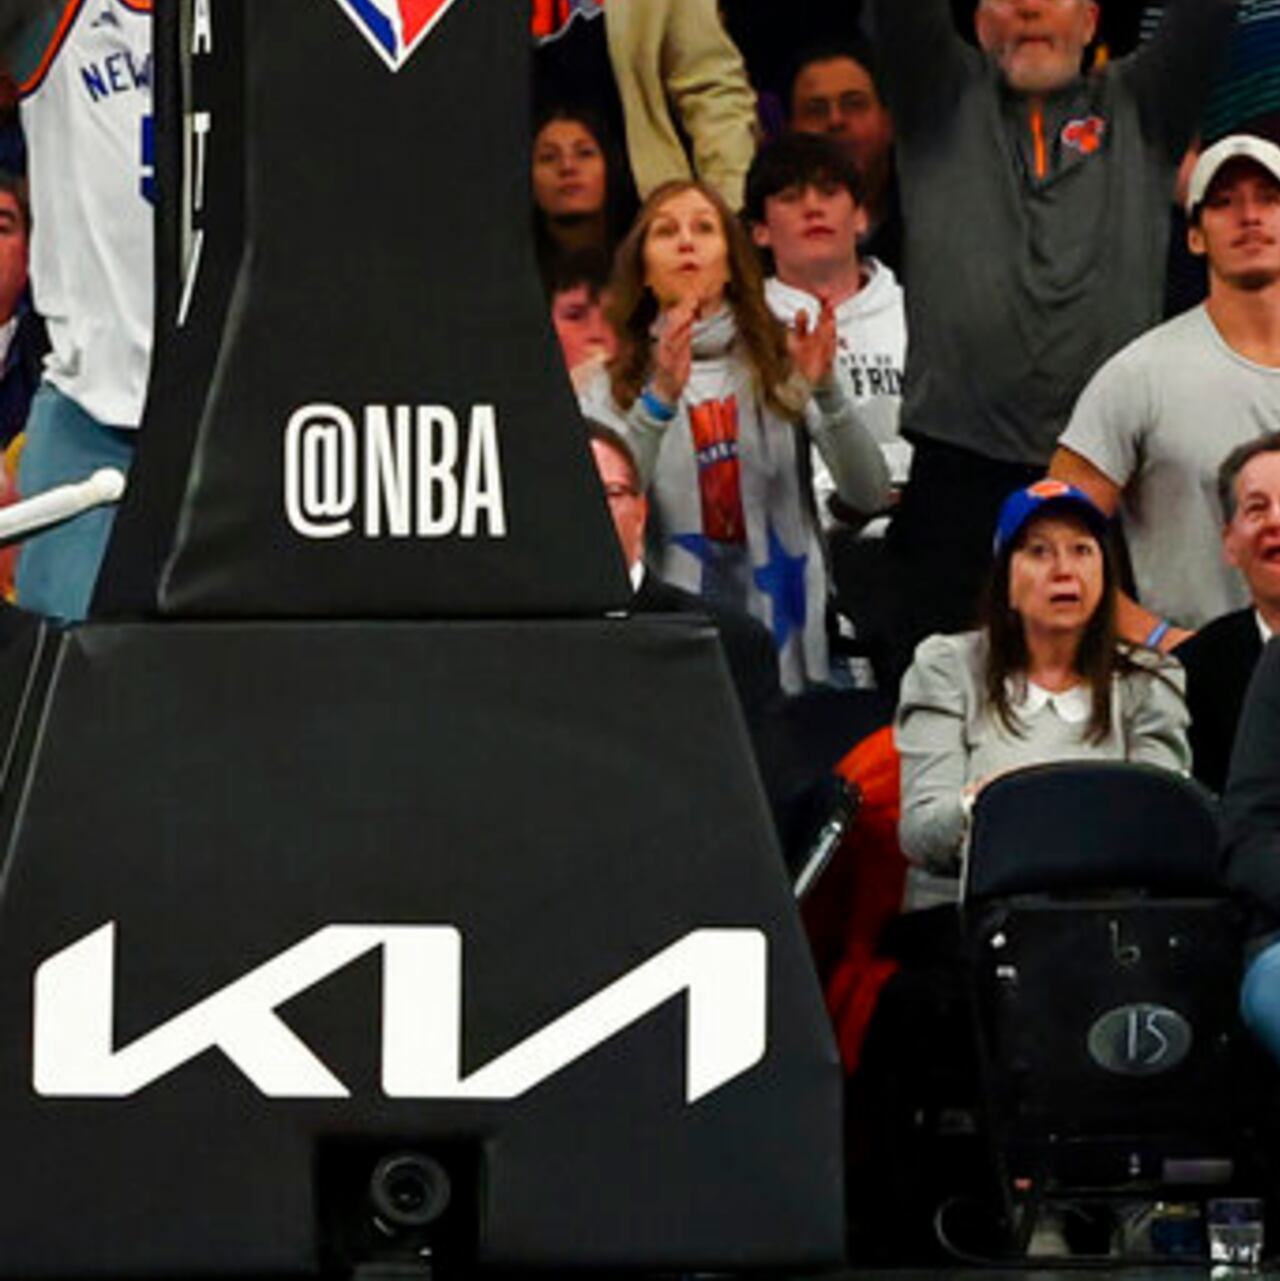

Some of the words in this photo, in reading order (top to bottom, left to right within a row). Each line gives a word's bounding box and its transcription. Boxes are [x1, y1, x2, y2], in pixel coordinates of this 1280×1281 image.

[284, 402, 507, 538] @NBA
[33, 919, 766, 1105] KIA
[1127, 1006, 1176, 1064] 15
